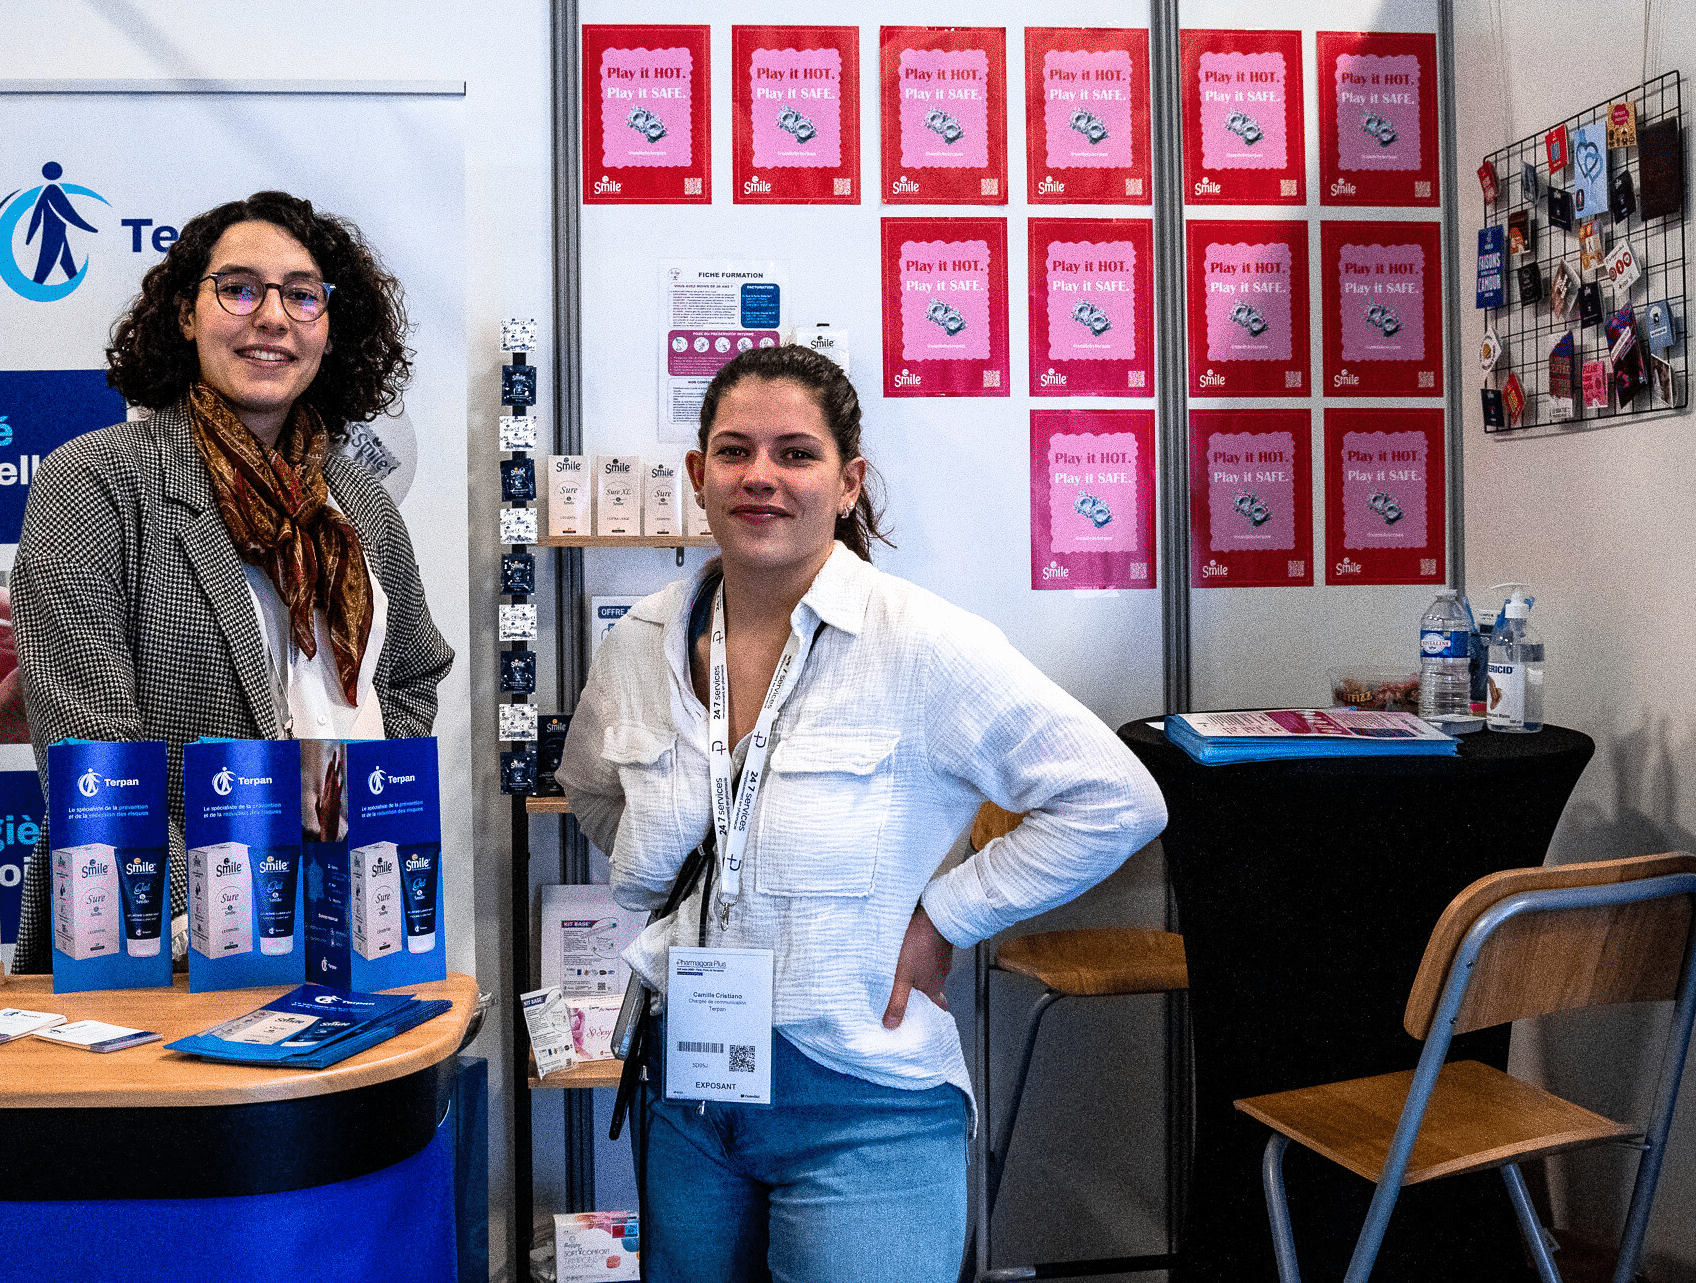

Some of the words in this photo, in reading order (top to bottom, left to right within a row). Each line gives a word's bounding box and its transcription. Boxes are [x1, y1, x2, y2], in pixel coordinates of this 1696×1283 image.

[607, 68, 635, 80] Play
[640, 68, 649, 78] it
[654, 68, 686, 78] HOT.
[757, 68, 785, 81] Play
[790, 68, 798, 79] it
[804, 68, 835, 79] HOT.
[905, 68, 933, 82] Play
[937, 69, 946, 79] it
[951, 69, 982, 80] HOT.
[1049, 69, 1077, 82] Play
[1082, 69, 1090, 80] it
[1095, 70, 1126, 81] HOT.
[1205, 71, 1232, 84] Play
[1237, 71, 1244, 82] it
[1250, 72, 1280, 82] HOT.
[1341, 72, 1367, 86] Play
[1372, 73, 1380, 84] it
[1385, 74, 1414, 85] HOT.
[607, 87, 634, 100] Play
[639, 87, 646, 98] it
[652, 88, 686, 98] SAFE.
[757, 88, 783, 100] Play
[788, 88, 796, 99] it
[801, 88, 835, 99] SAFE.
[905, 88, 931, 101] Play
[936, 88, 943, 99] it
[949, 89, 982, 100] SAFE.
[1049, 89, 1075, 101] Play
[1080, 89, 1088, 100] it
[1093, 89, 1126, 100] SAFE.
[1205, 91, 1230, 103] Play
[1235, 91, 1243, 102] it
[1248, 91, 1280, 102] SAFE.
[1341, 92, 1366, 105] Play
[1371, 93, 1378, 104] it
[1383, 93, 1414, 105] SAFE.
[594, 180, 621, 194] Smile
[744, 180, 771, 195] Smile
[893, 180, 919, 194] Smile
[1038, 180, 1065, 194] Smile
[1195, 181, 1221, 195] Smile
[1331, 182, 1356, 196] Smile
[906, 260, 934, 274] Play
[939, 260, 947, 271] it
[952, 260, 984, 271] HOT.
[1053, 261, 1080, 274] Play
[1085, 261, 1093, 272] it
[1098, 261, 1129, 272] HOT.
[1210, 262, 1237, 275] Play
[1242, 262, 1250, 273] it
[1255, 263, 1285, 273] HOT.
[1345, 263, 1371, 276] Play
[1376, 263, 1384, 274] it
[1389, 264, 1418, 274] HOT.
[906, 280, 932, 293] Play
[937, 280, 945, 291] it
[950, 280, 984, 291] SAFE.
[1053, 280, 1078, 293] Play
[1083, 281, 1091, 291] it
[1096, 281, 1129, 292] SAFE.
[1210, 282, 1236, 294] Play
[1240, 282, 1248, 293] it
[1253, 282, 1285, 293] SAFE.
[1345, 282, 1370, 295] Play
[1375, 283, 1382, 293] it
[1387, 283, 1419, 294] SAFE.
[811, 339, 834, 349] Smile
[894, 373, 921, 388] Smile
[1040, 372, 1067, 387] Smile
[1199, 373, 1225, 388] Smile
[1334, 373, 1359, 387] Smile
[1055, 453, 1082, 466] Play
[1087, 453, 1095, 464] it
[1100, 453, 1131, 464] HOT.
[1214, 452, 1240, 465] Play
[1245, 452, 1253, 462] it
[1258, 452, 1288, 463] HOT.
[1348, 451, 1374, 464] Play
[1379, 451, 1387, 461] it
[1392, 451, 1421, 462] HOT.
[556, 461, 581, 472] Smile
[605, 463, 630, 474] Smile
[651, 468, 673, 478] Smile
[1055, 473, 1081, 485] Play
[1085, 473, 1093, 484] it
[1098, 473, 1131, 484] SAFE.
[1214, 472, 1239, 484] Play
[1244, 471, 1251, 482] it
[1256, 471, 1289, 482] SAFE.
[1348, 470, 1373, 482] Play
[1377, 470, 1385, 481] it
[1389, 470, 1421, 481] SAFE.
[560, 486, 578, 494] Sure
[606, 488, 619, 496] Sure
[655, 490, 671, 498] Sure
[1043, 565, 1069, 580] Smile
[1202, 563, 1228, 578] Smile
[1336, 561, 1361, 575] Smile
[601, 608, 625, 616] OFFRE
[713, 665, 721, 700] services
[714, 709, 721, 720] 24
[546, 723, 567, 732] Smile
[104, 779, 139, 787] Terpan
[238, 777, 273, 786] Terpan
[388, 775, 415, 785] Terpan
[750, 771, 758, 783] 24
[715, 777, 725, 815] services
[739, 793, 752, 832] services
[719, 824, 727, 835] 24
[82, 863, 108, 878] Smile
[126, 862, 155, 875] Smile
[216, 862, 242, 877] Smile
[260, 860, 288, 874] Smile
[372, 861, 393, 877] Smile
[405, 857, 429, 872] Smile
[87, 894, 105, 904] Sure
[220, 894, 239, 903] Sure
[375, 893, 391, 904] Sure
[695, 1081, 736, 1091] EXPOSANT
